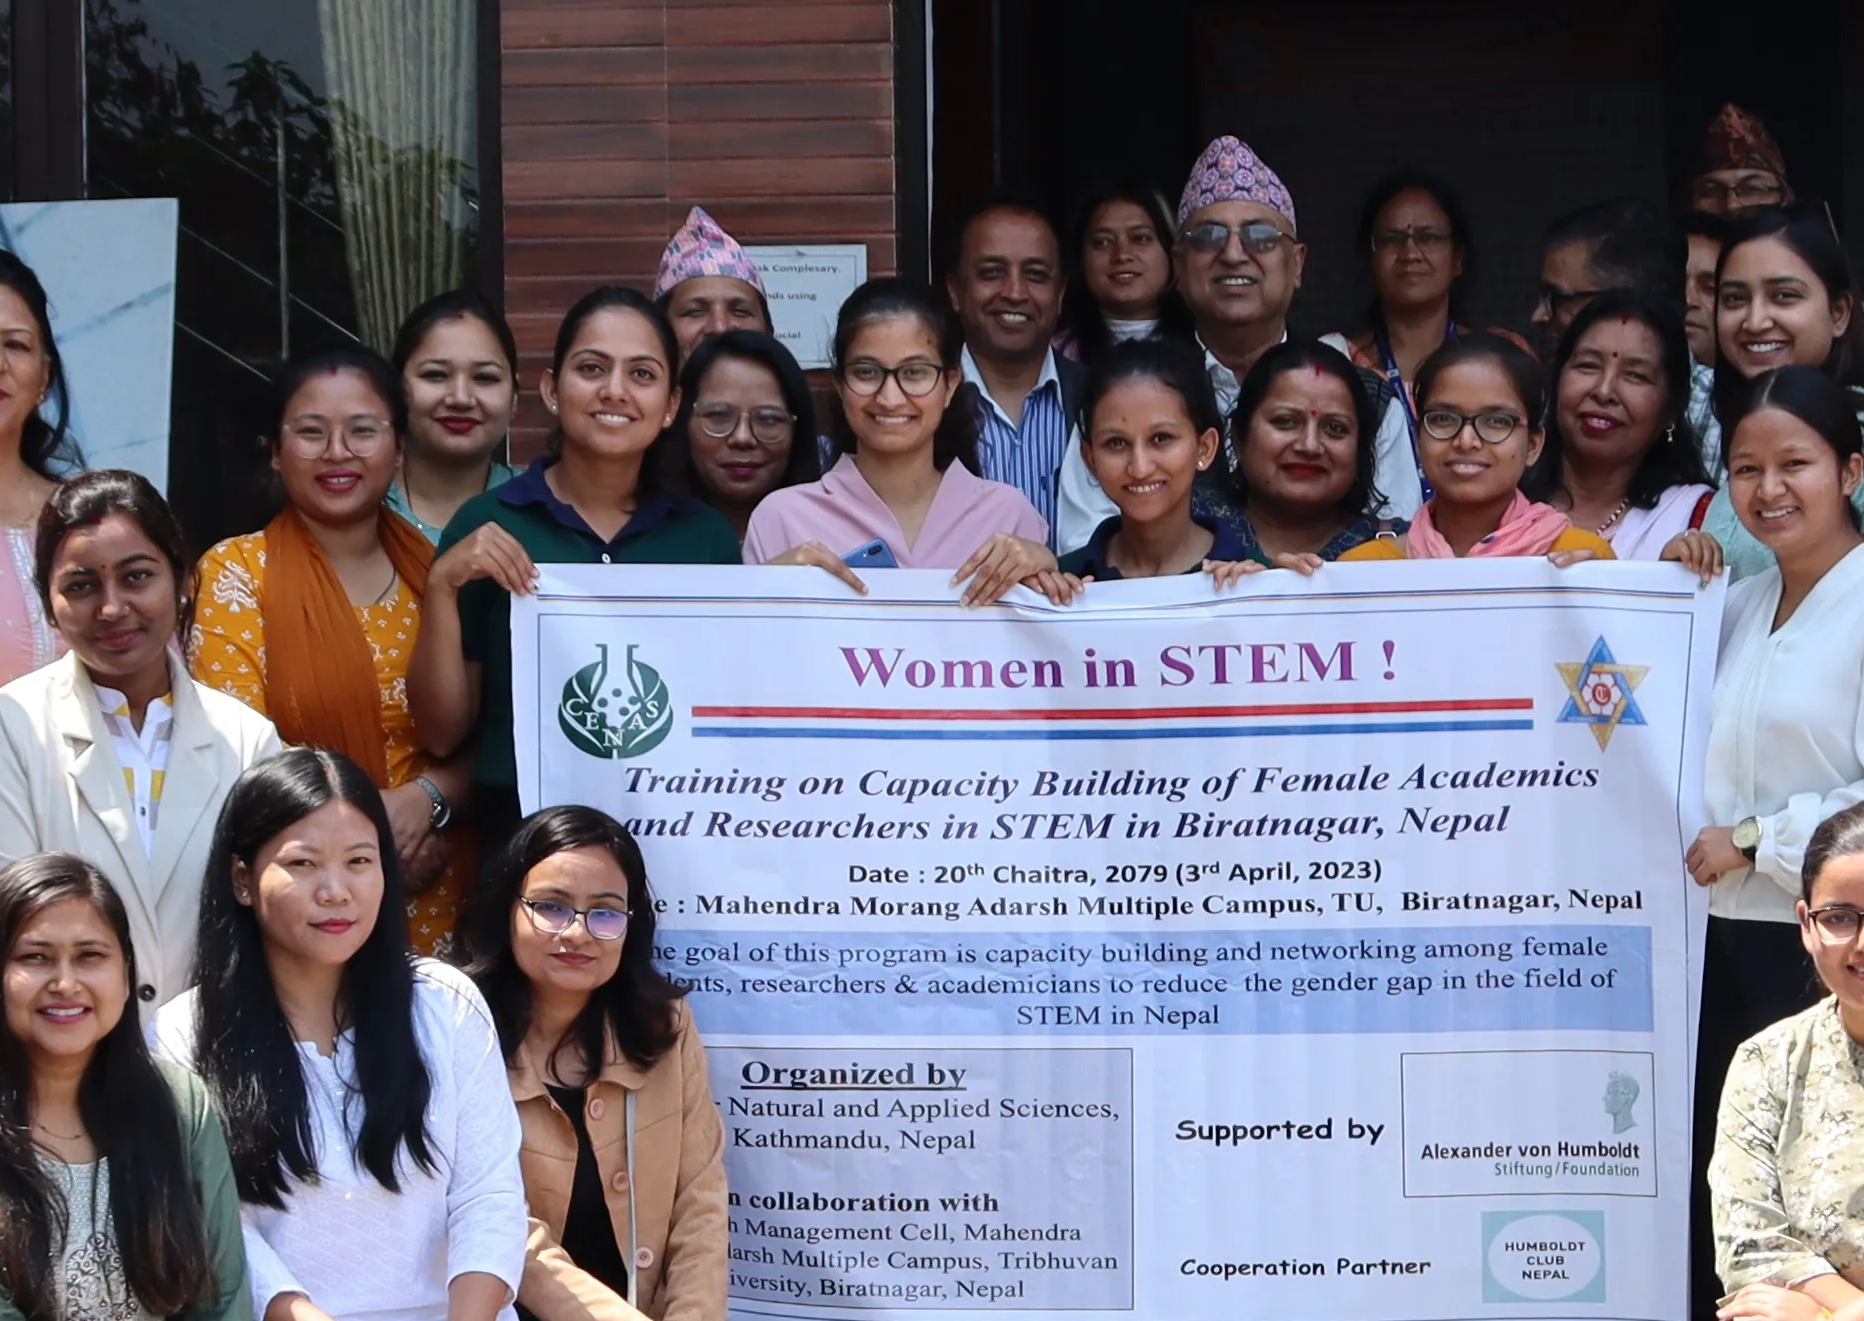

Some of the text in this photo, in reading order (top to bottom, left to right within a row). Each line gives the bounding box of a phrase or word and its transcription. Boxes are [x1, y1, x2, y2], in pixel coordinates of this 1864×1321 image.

[788, 292, 816, 301] using
[838, 639, 1396, 689] Women in STEM !
[565, 698, 660, 747] CENAS
[624, 759, 1600, 805] Training on Capacity Building of Female Academics
[624, 804, 1512, 844] and Researchers in STEM in Biratnagar, Nepal
[848, 858, 1383, 889] Date : 20th Chaitra, 2079 (3rd April, 2023)
[695, 894, 841, 916] Mahendra
[848, 895, 961, 922] Morang
[966, 895, 1069, 917] Adarsh
[1076, 893, 1195, 922] Multiple
[1201, 891, 1324, 920] Campus,
[1330, 891, 1384, 916] TU,
[1400, 890, 1561, 915] Biratnagar,
[1567, 888, 1644, 915] Nepal
[652, 935, 1608, 970] he goal of this program is capacity building and networking among female
[740, 974, 886, 996] researchers
[895, 975, 918, 995] &
[927, 974, 1101, 996] academicians
[1111, 977, 1134, 995] to
[1143, 973, 1228, 994] reduce
[1245, 972, 1283, 993] the
[1291, 972, 1378, 999] gender
[1387, 974, 1433, 998] gap
[1441, 968, 1467, 991] in
[1474, 968, 1516, 989] the
[1523, 967, 1583, 990] field
[1589, 967, 1619, 989] of
[1016, 1003, 1220, 1030] STEM in Nepal
[741, 1060, 966, 1088] Organized by
[726, 1095, 1122, 1125] Natural and Applied Sciences,
[733, 1127, 976, 1156] Kathmandu, Nepal
[1174, 1116, 1386, 1148] Supported by
[1420, 1140, 1641, 1161] Alexander von Humboldt
[1494, 1159, 1640, 1179] Stiftung/Foundation
[748, 1190, 932, 1213] collaboration
[937, 1192, 1000, 1213] with
[743, 1217, 894, 1246] Management
[899, 1222, 956, 1246] Cell,
[962, 1222, 1083, 1244] Mahendra
[728, 1243, 1118, 1275] arsh Multiple Campus, Tribhuvan
[1504, 1240, 1586, 1253] HUMBOLDT
[1525, 1254, 1565, 1268] CLUB
[1179, 1257, 1432, 1282] Cooperation Partner
[1521, 1267, 1571, 1281] NEPAL
[730, 1272, 1025, 1304] iversity, Biratnagar, Nepal
